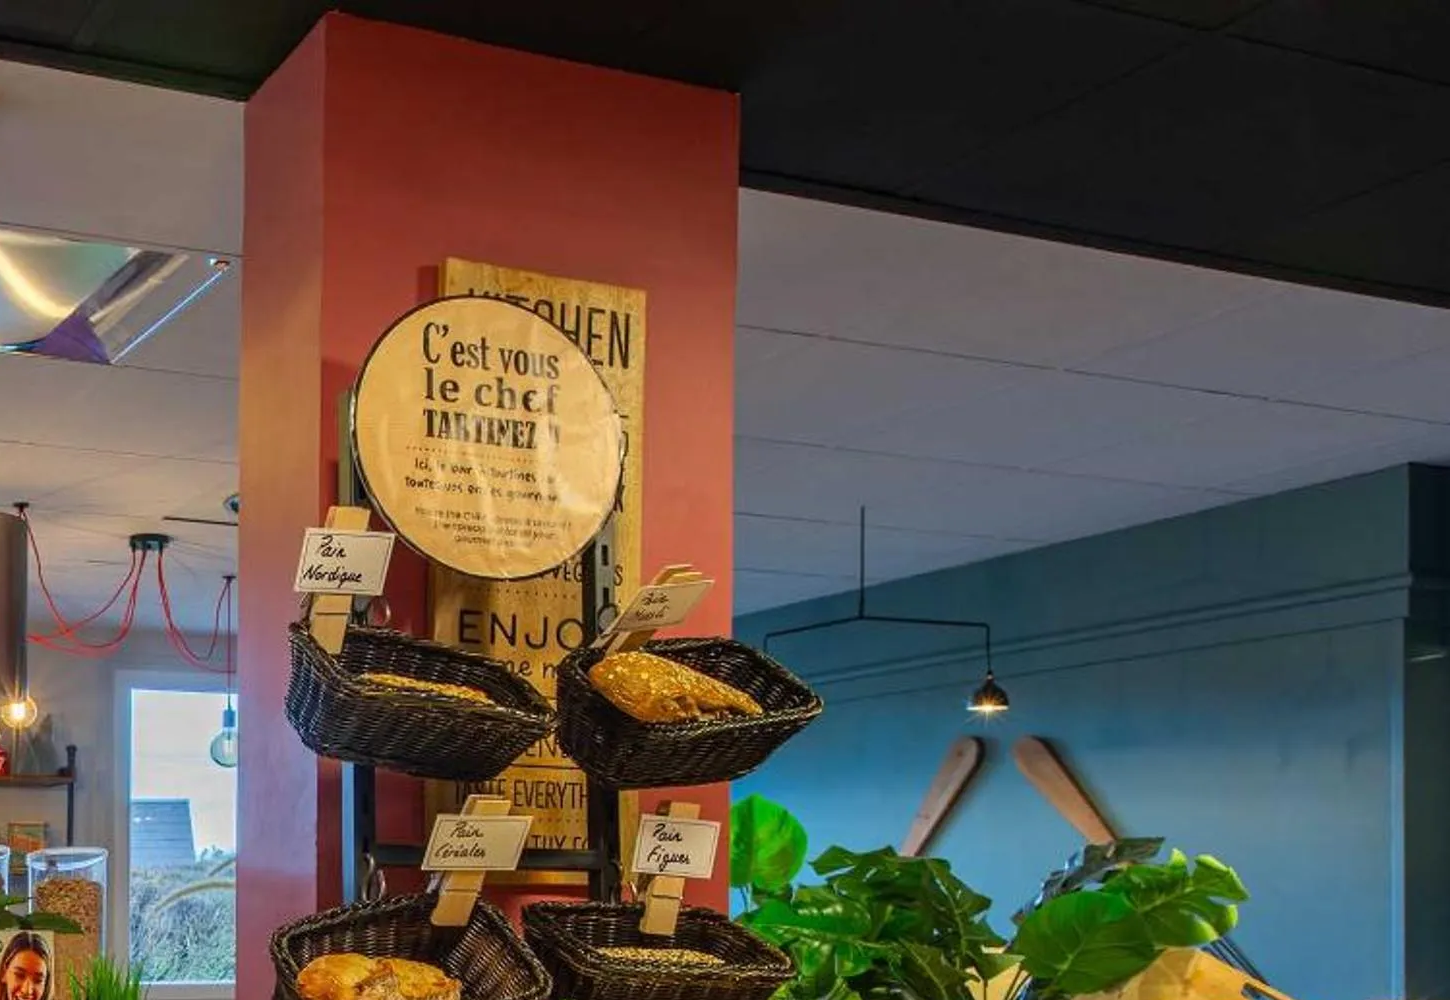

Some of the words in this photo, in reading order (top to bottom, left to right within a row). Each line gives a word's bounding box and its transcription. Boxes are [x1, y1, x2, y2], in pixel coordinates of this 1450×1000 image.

[422, 321, 490, 371] C'est
[498, 347, 560, 380] vous
[424, 367, 460, 403] le
[474, 377, 560, 415] chef
[317, 535, 347, 558] Pain
[302, 564, 362, 589] Nordique
[458, 608, 585, 651] ENJO
[513, 779, 588, 810] EVERYTH
